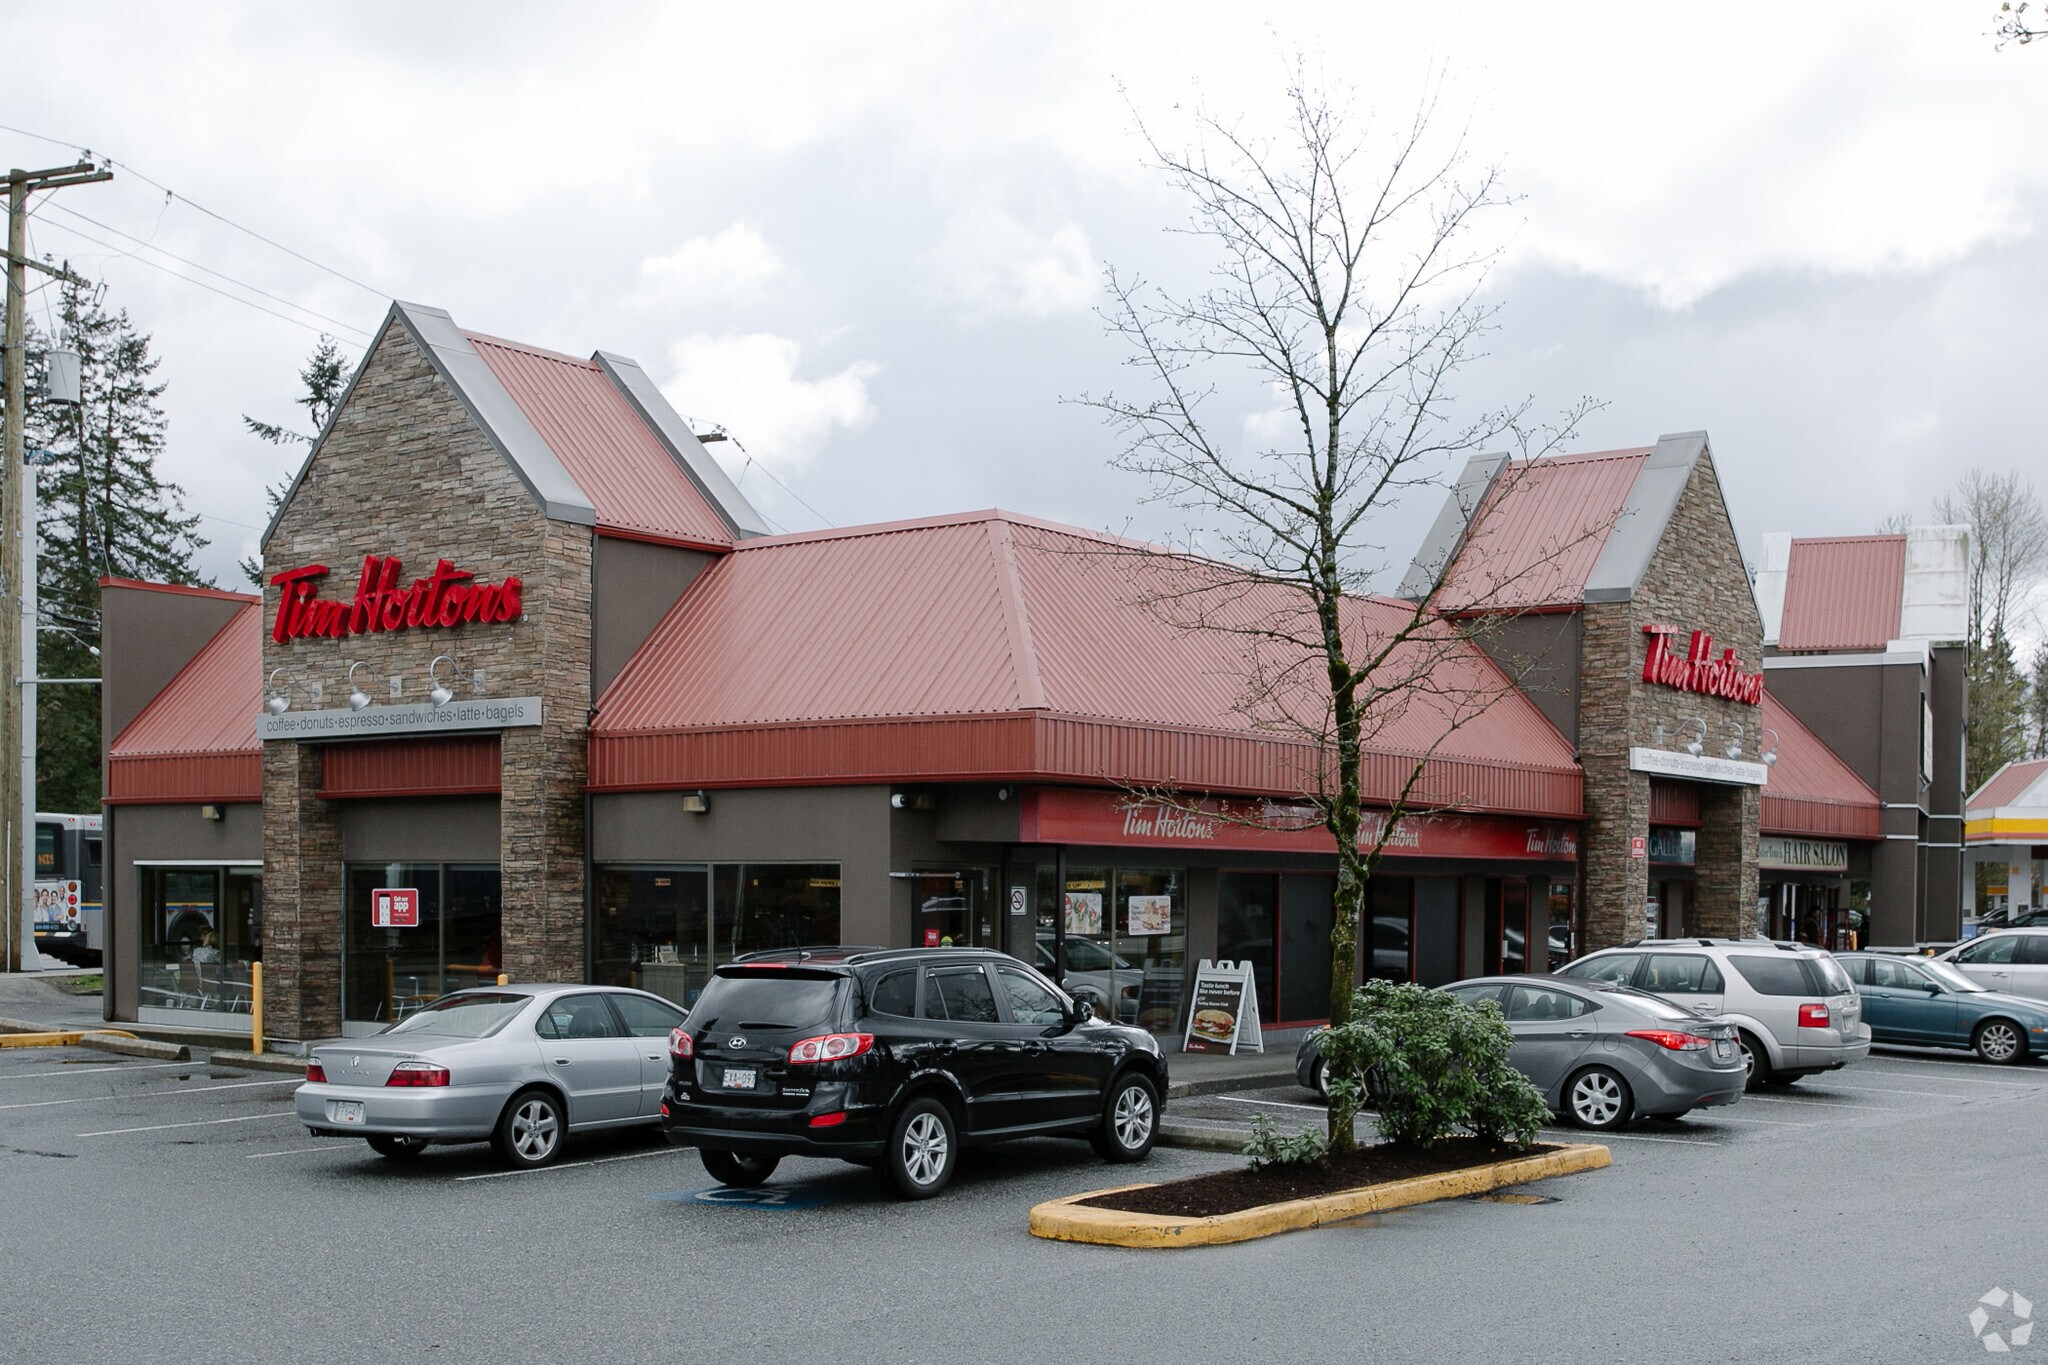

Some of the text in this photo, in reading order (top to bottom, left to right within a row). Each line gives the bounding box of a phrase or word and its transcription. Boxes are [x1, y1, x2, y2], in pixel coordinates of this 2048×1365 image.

[270, 555, 522, 644] Tim Hortons
[1642, 624, 1690, 692] Tim
[266, 704, 524, 732] coffee donuts espresso sandwiches latte bagels
[1121, 804, 1214, 839] Tim Hortons
[1374, 817, 1419, 847] Hrtons
[1526, 828, 1577, 853] Tim Horton
[1783, 841, 1811, 865] HAIR
[1813, 843, 1846, 866] SALON
